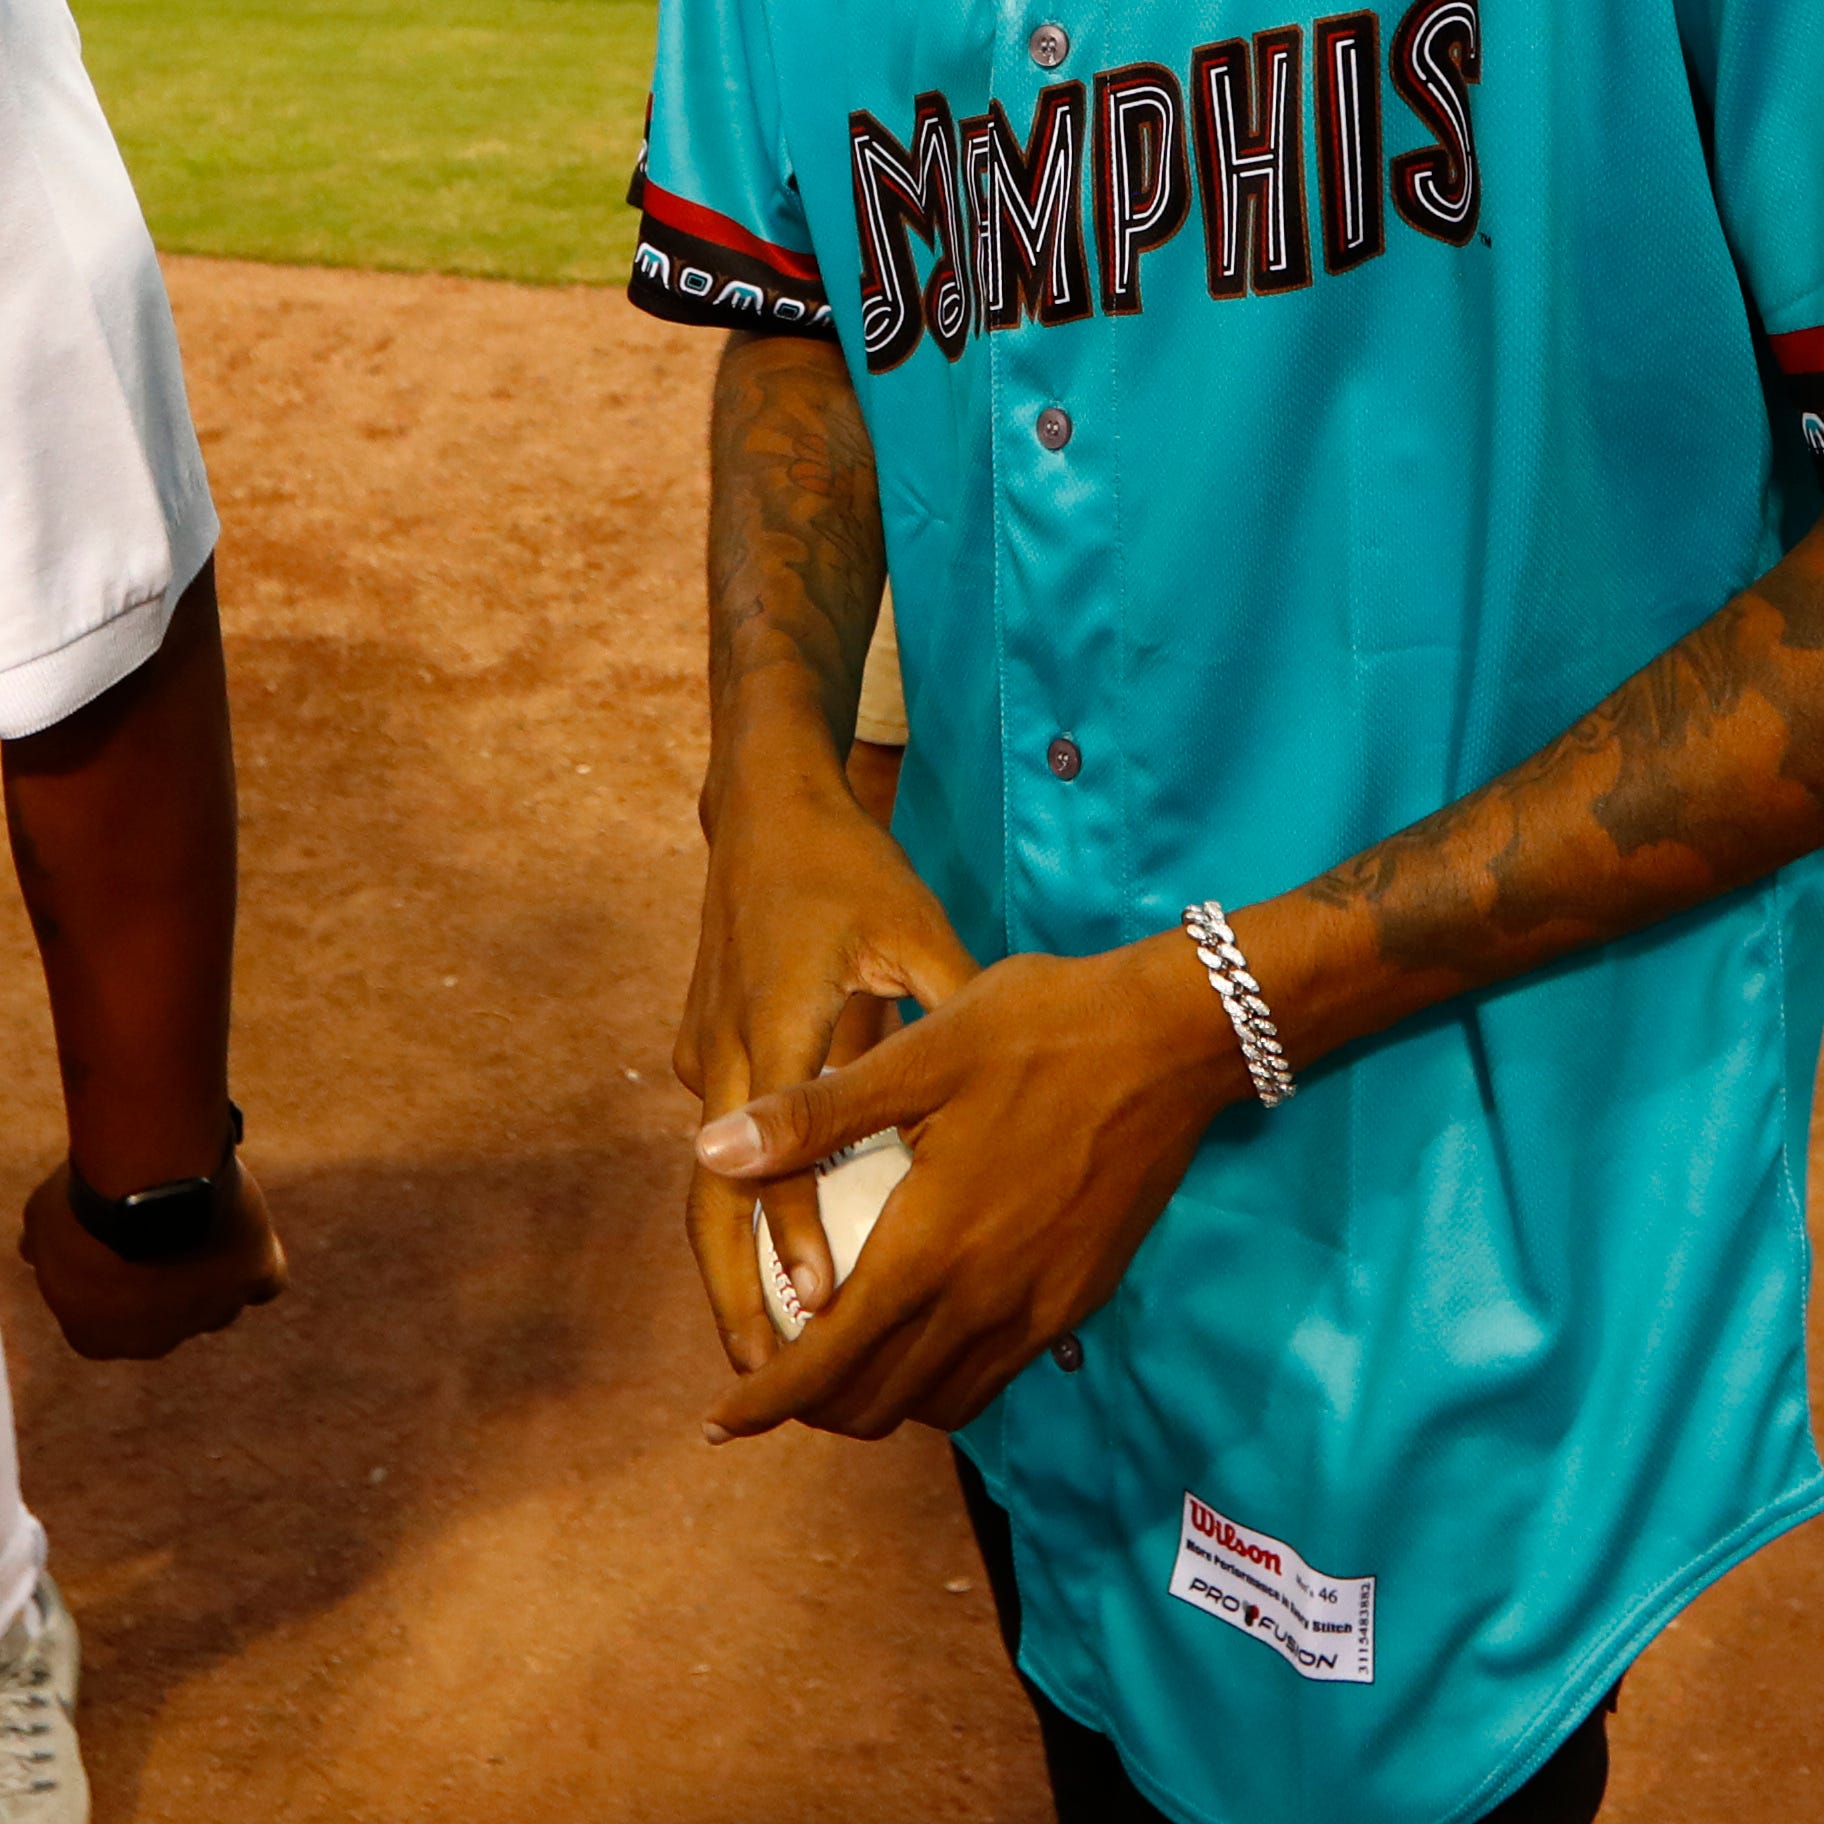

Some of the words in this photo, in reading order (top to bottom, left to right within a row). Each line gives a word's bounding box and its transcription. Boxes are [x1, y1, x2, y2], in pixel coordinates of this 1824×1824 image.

[1189, 1499, 1282, 1577] Wilson
[1318, 1587, 1338, 1604] 46
[1312, 1620, 1353, 1634] Stitch
